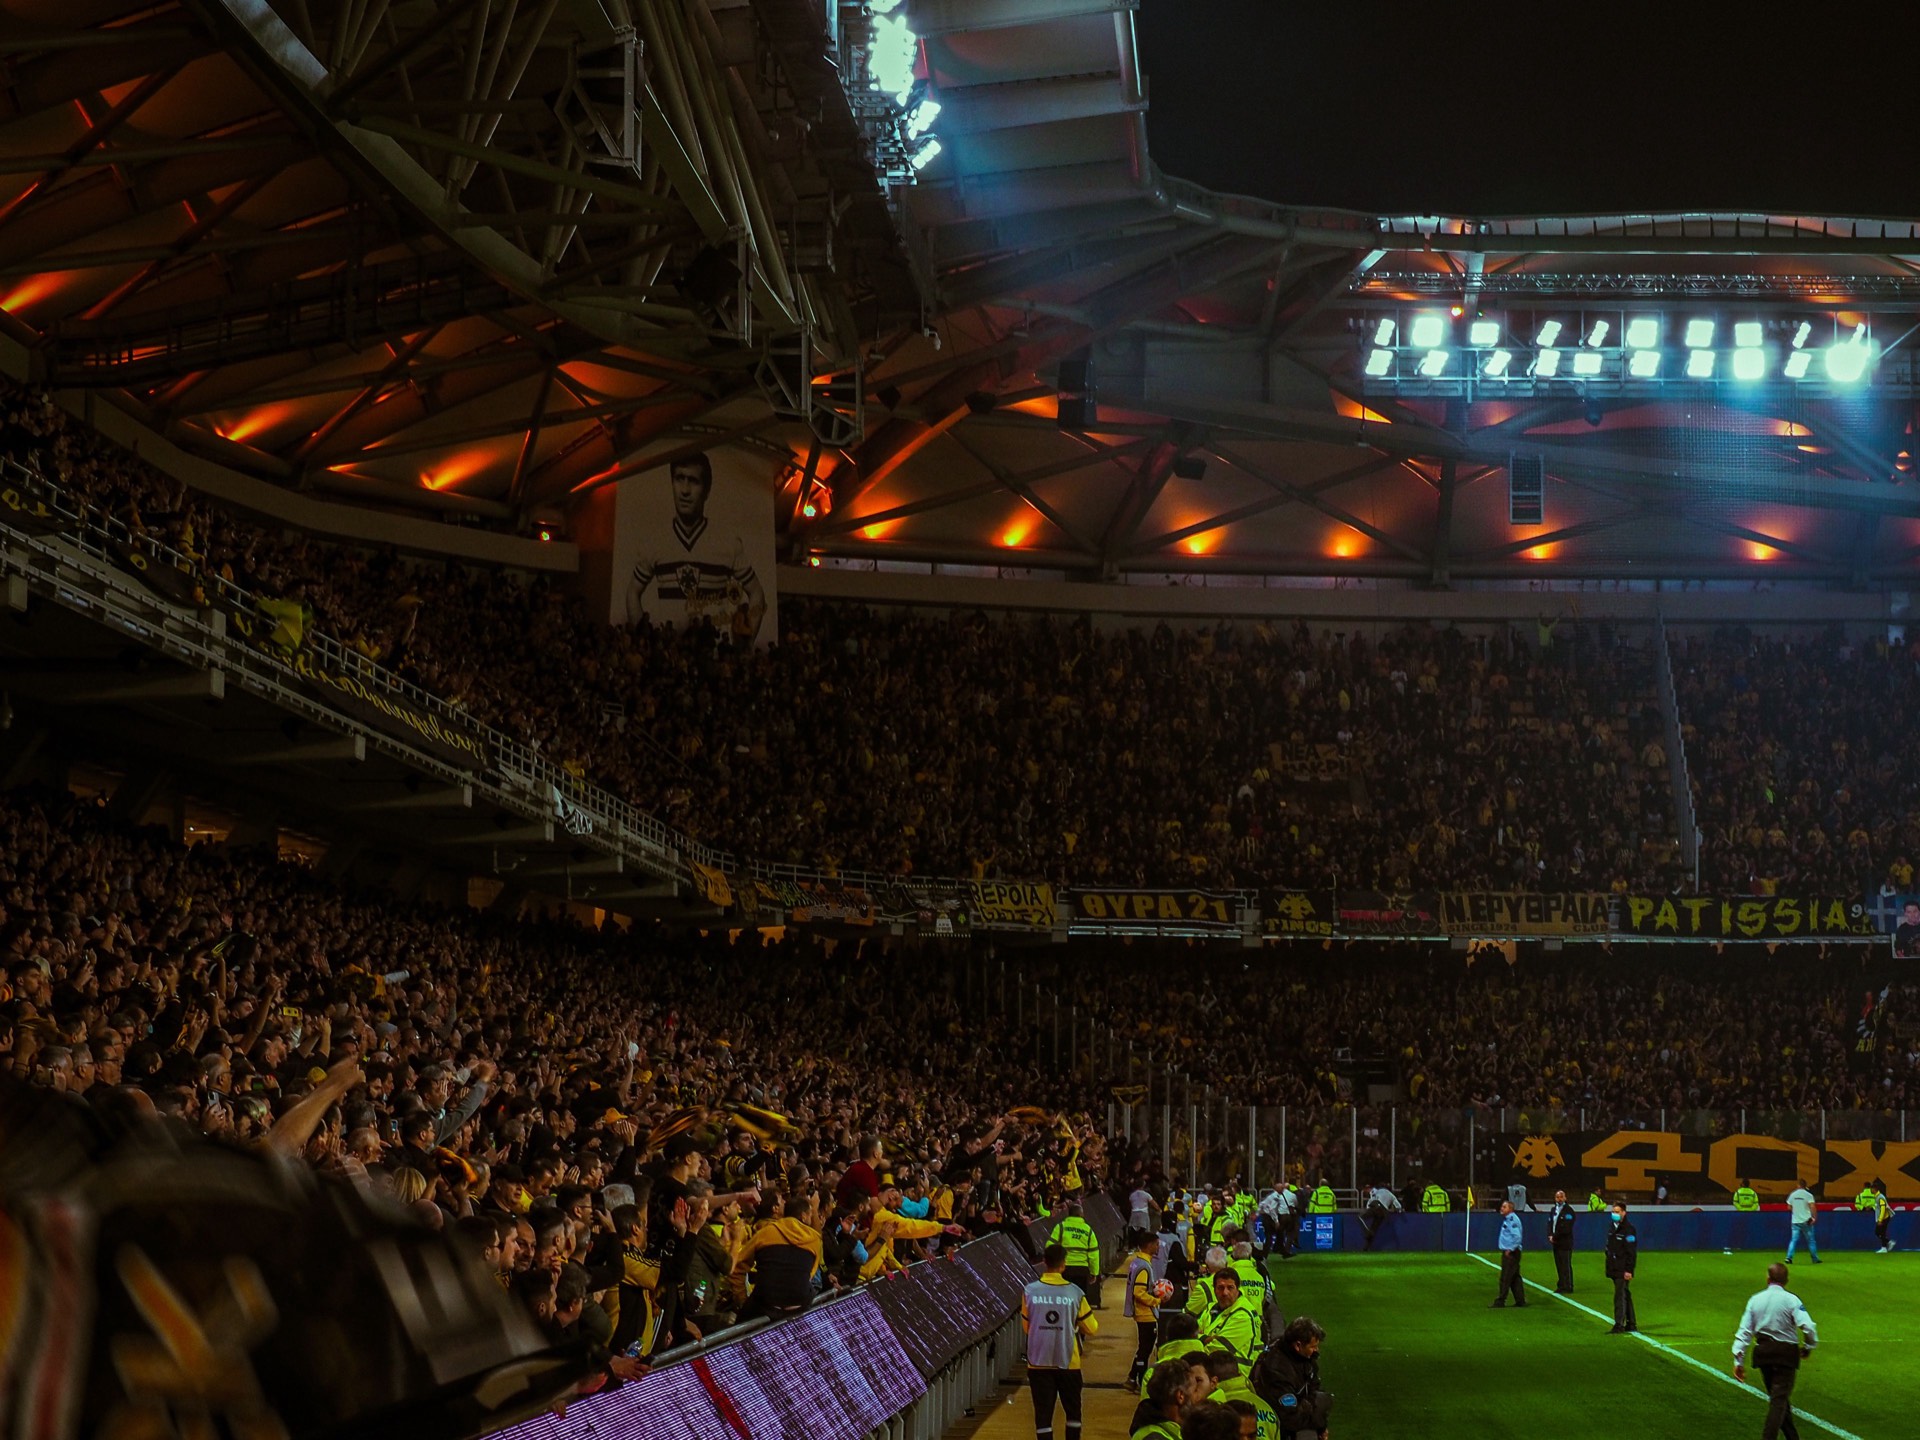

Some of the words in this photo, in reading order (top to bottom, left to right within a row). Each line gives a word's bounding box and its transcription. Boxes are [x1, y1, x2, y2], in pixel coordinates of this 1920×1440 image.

[970, 881, 1042, 905] ΒΕΡΟΙΑ
[1081, 894, 1182, 919] ΘΥΡΑ
[1187, 894, 1228, 922] 21
[1627, 896, 1851, 937] PATISSIA
[1447, 923, 1487, 933] SINCE
[1572, 923, 1609, 933] CLUB
[1032, 1295, 1054, 1305] BALL
[1056, 1296, 1074, 1306] BOY
